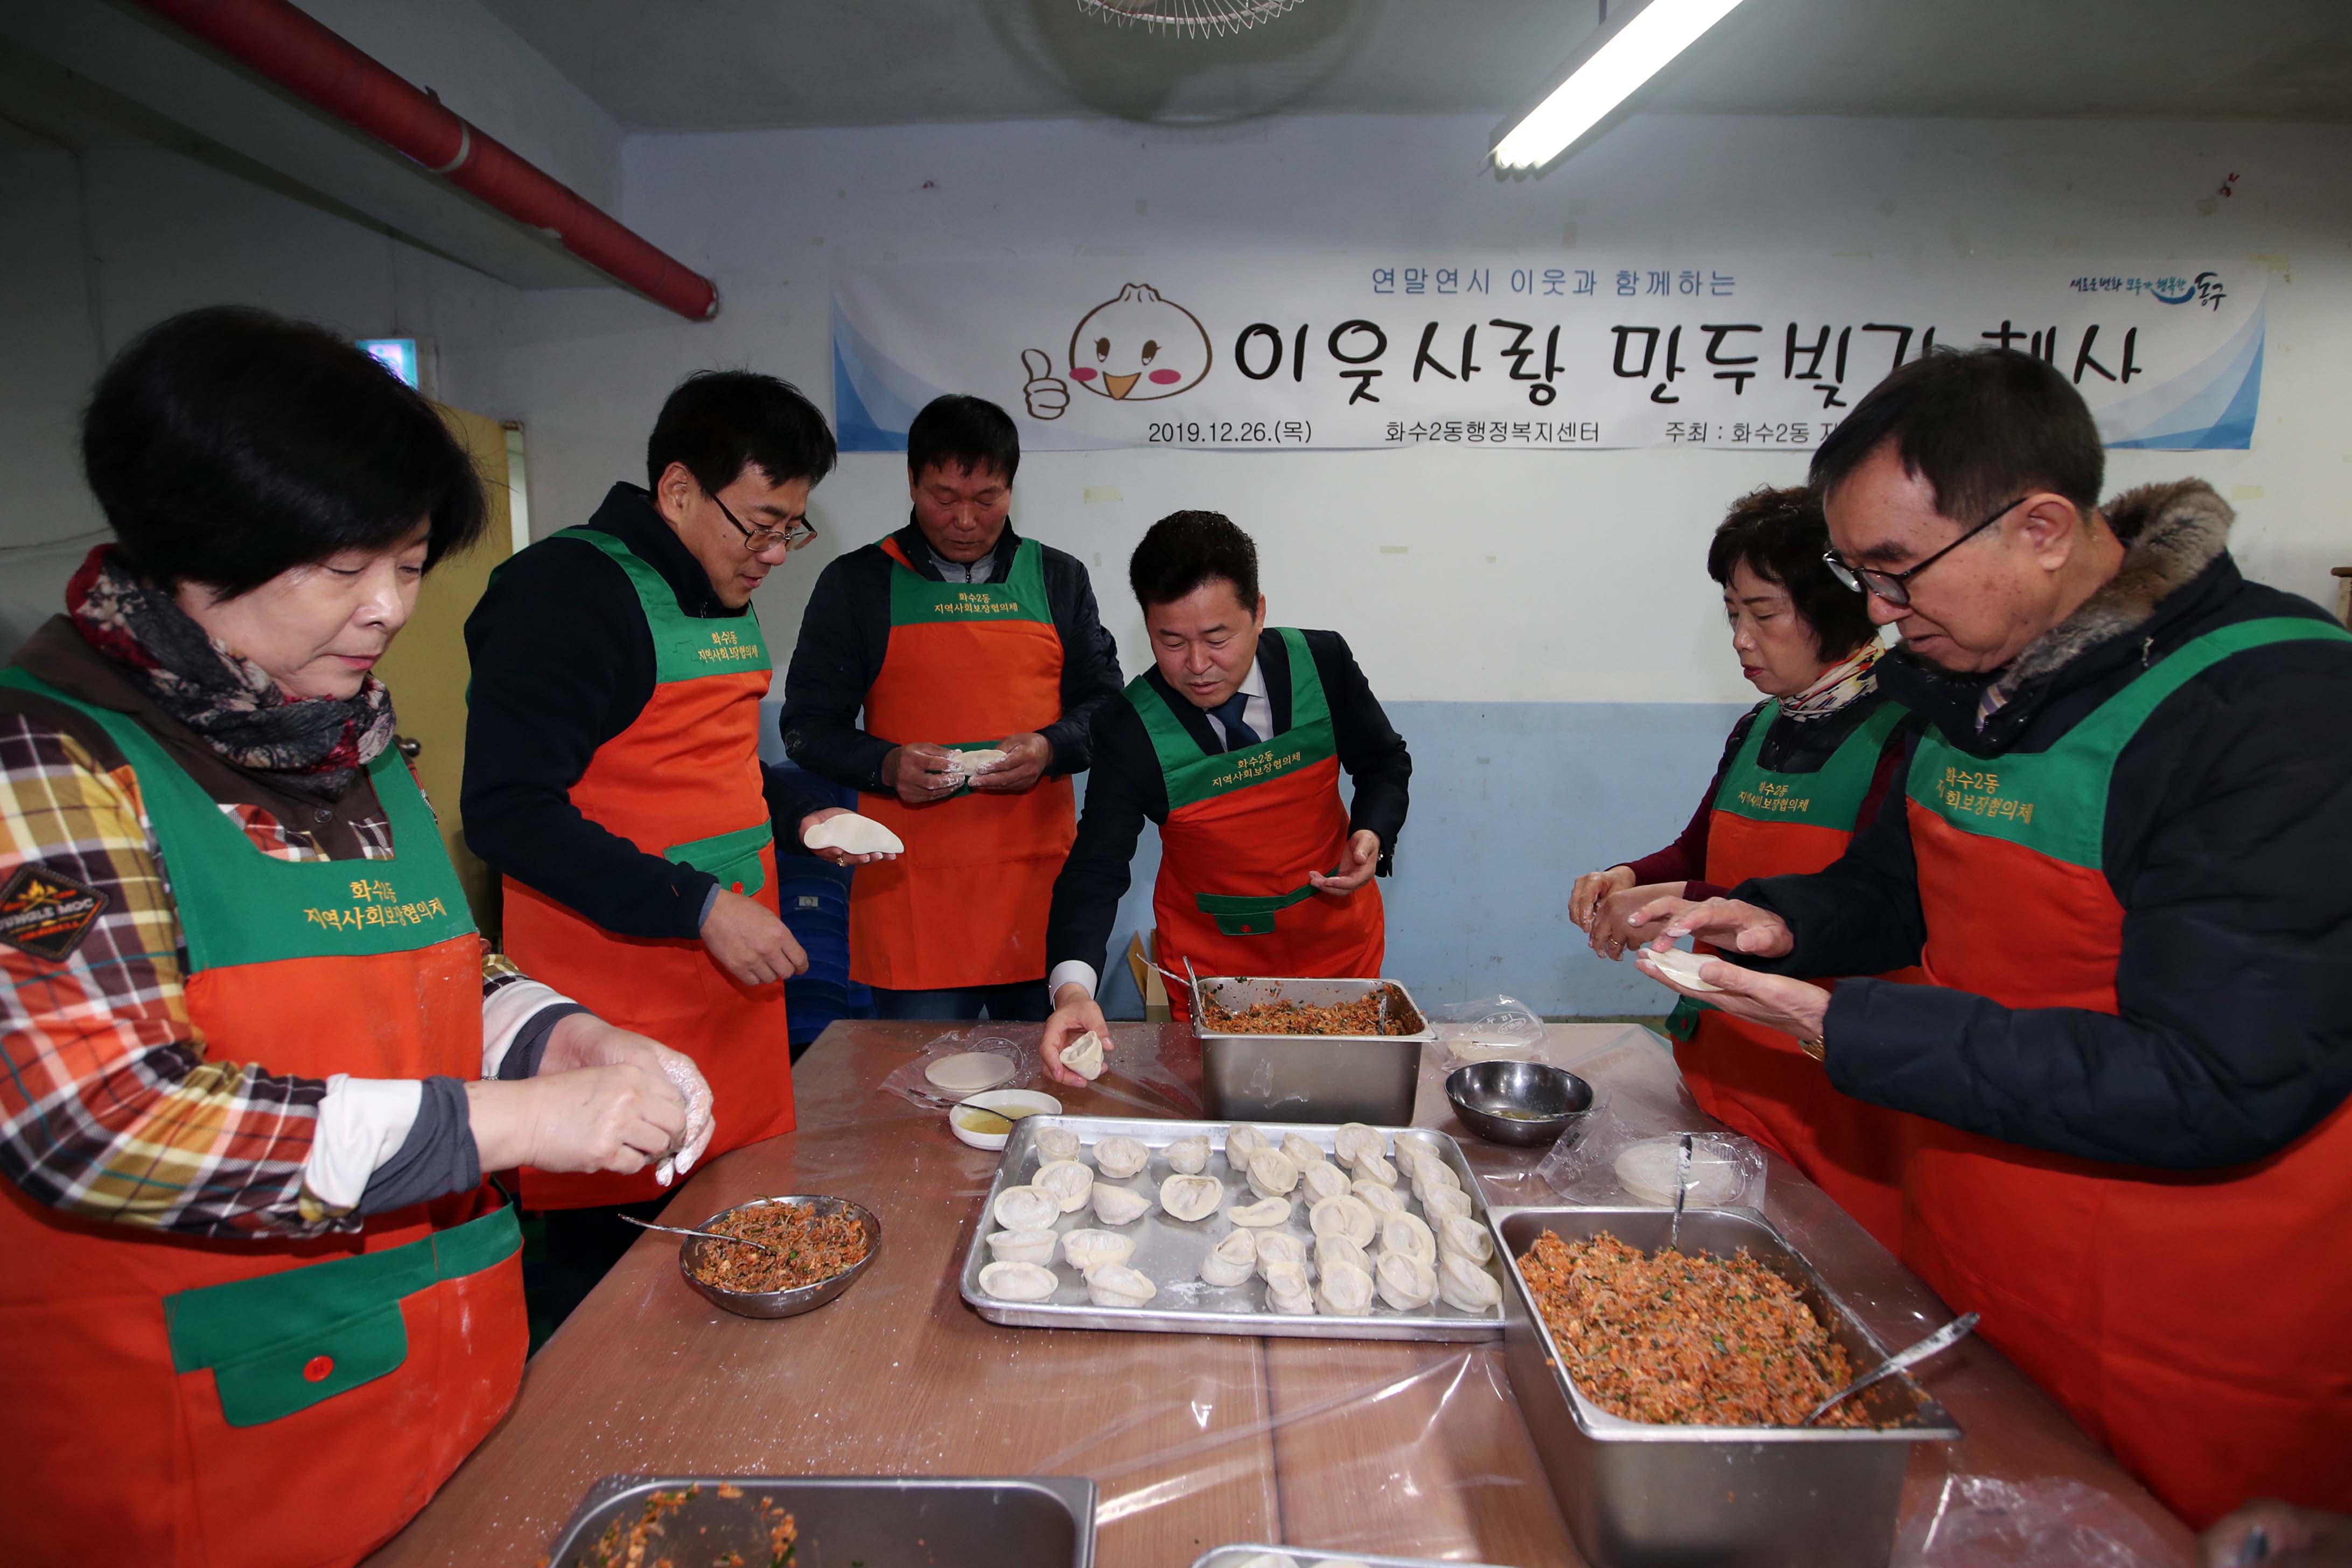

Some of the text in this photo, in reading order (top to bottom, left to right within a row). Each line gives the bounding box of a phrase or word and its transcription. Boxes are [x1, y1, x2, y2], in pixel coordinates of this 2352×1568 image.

[1371, 267, 1735, 297] 연말연시 이웃과 함께하는
[1235, 318, 1566, 407] 이웃사랑
[1148, 420, 1312, 444] 2019.12.26.(목)
[1384, 421, 1599, 443] 화수2동행정복지센터
[1665, 421, 1707, 443] 주최
[1731, 422, 1810, 443] 화수2동
[934, 602, 1019, 614] 지역사회보장협의체
[958, 592, 991, 604] 화수2동
[1212, 752, 1301, 787] 지역사회보장협의체
[1237, 750, 1274, 768] 화수2동
[1945, 767, 2000, 794] 화수2동
